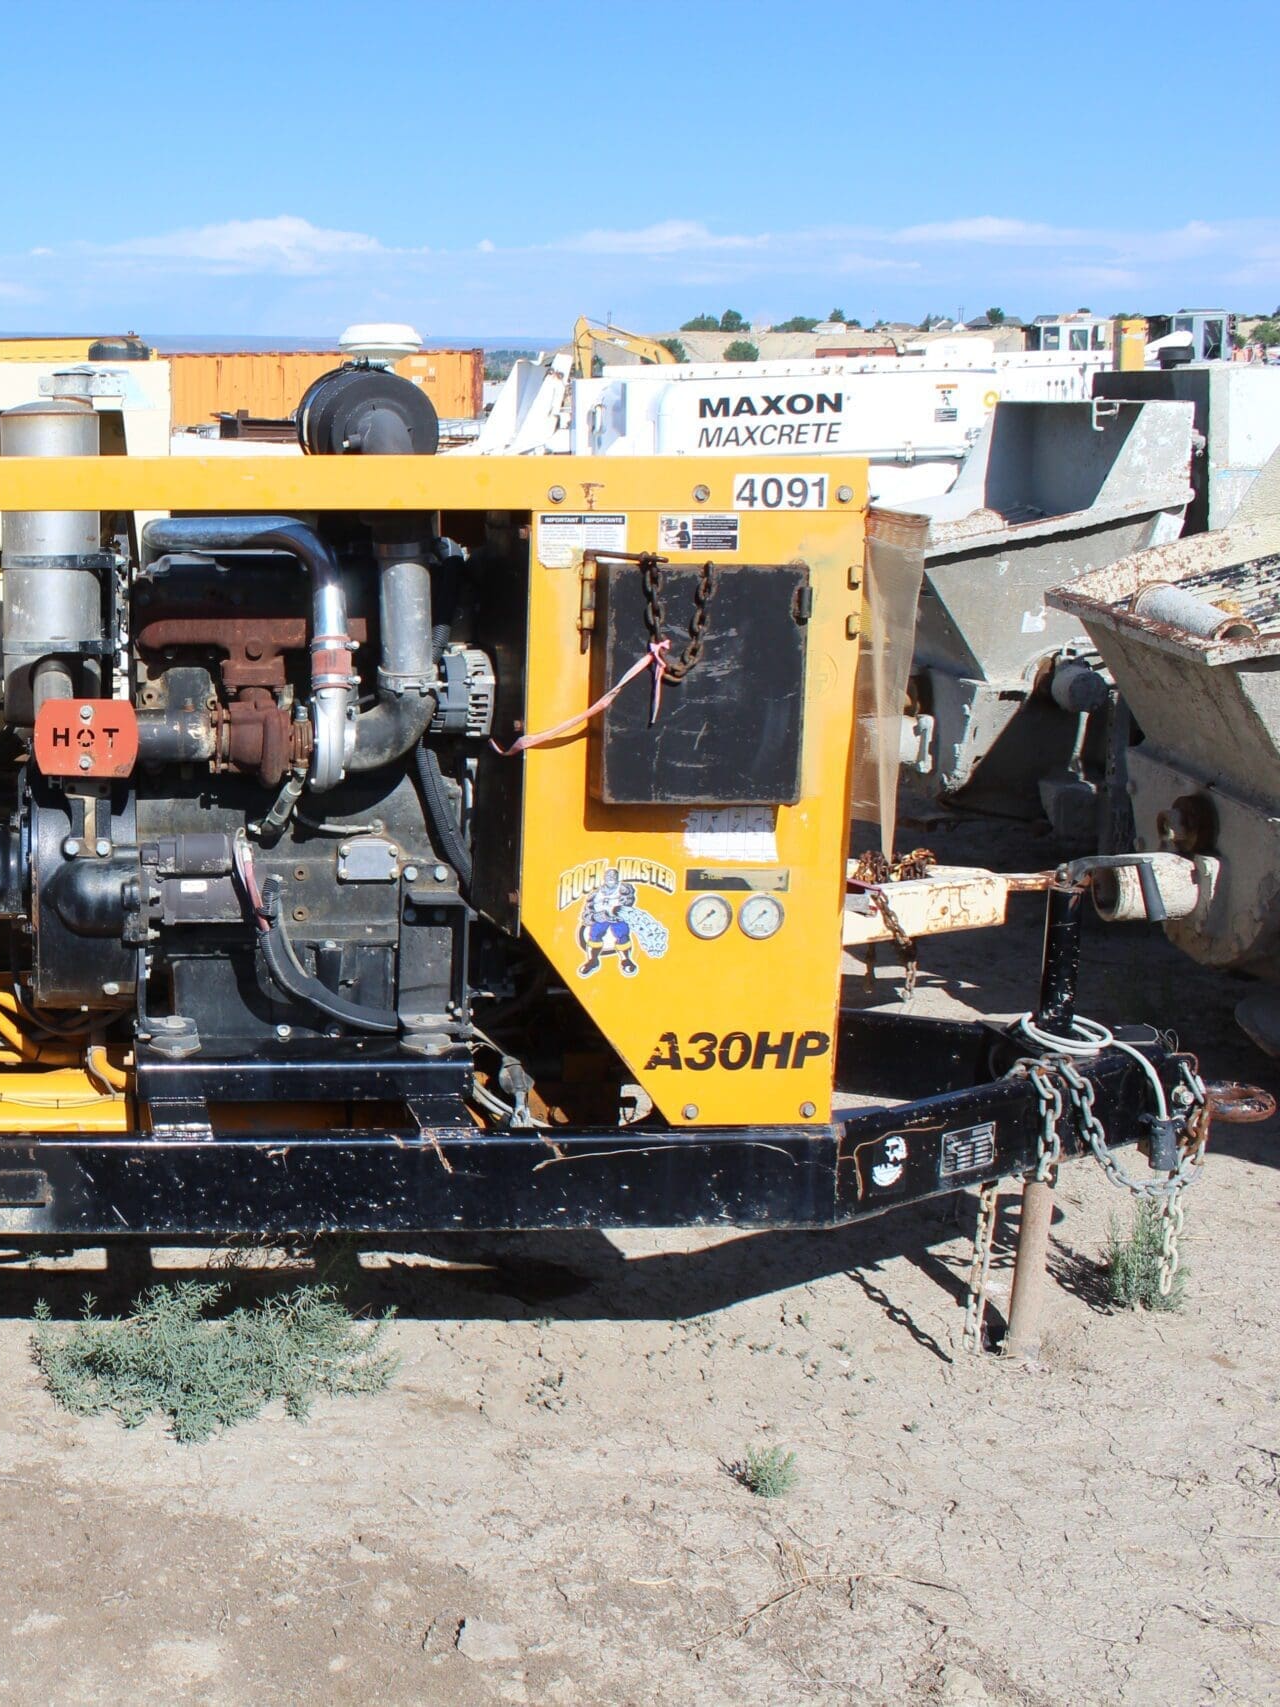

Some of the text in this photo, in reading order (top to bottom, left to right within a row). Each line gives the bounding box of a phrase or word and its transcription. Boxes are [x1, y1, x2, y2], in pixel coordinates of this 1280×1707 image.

[698, 392, 843, 418] MAXON
[697, 421, 843, 448] MAXCRETE
[735, 477, 825, 508] 4091
[52, 727, 120, 748] HOT
[559, 859, 674, 911] ROCK MASTER
[643, 1031, 831, 1071] A30HP
